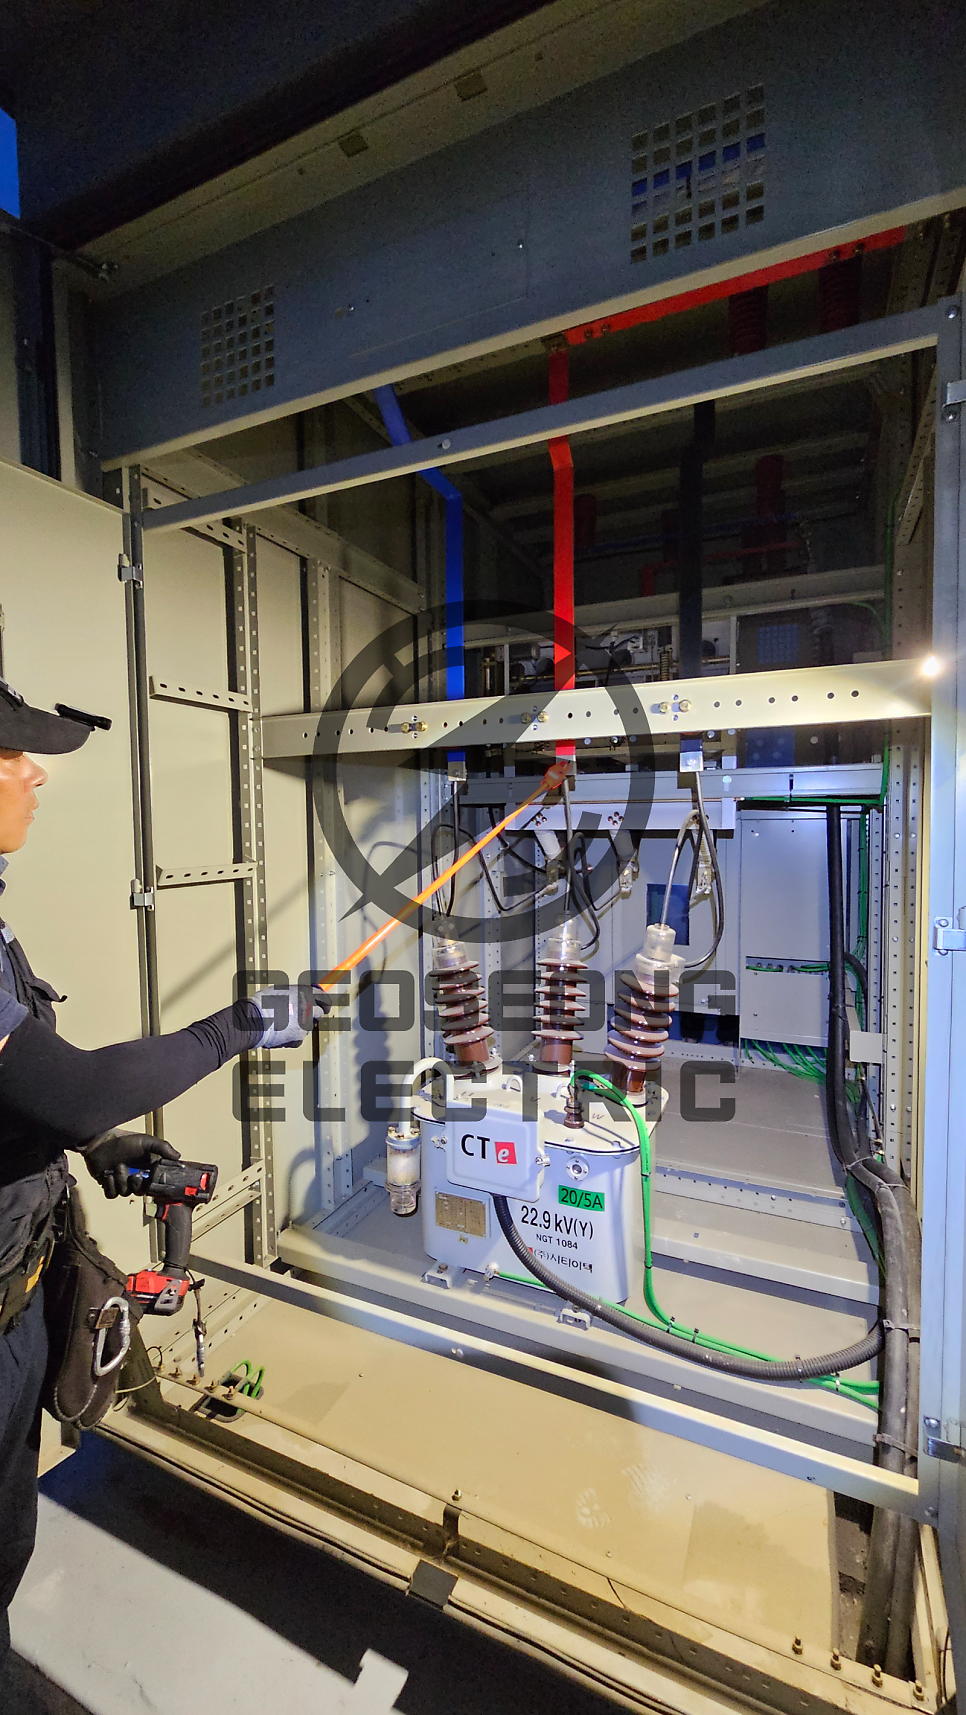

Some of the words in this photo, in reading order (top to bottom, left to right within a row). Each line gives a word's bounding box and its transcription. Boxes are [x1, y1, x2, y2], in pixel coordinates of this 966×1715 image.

[461, 1134, 490, 1160] CT
[561, 1188, 603, 1209] 20/5A
[521, 1205, 551, 1230] 22.9
[555, 1213, 594, 1240] kV(Y)
[536, 1233, 553, 1244] NGT
[556, 1238, 578, 1250] 1084
